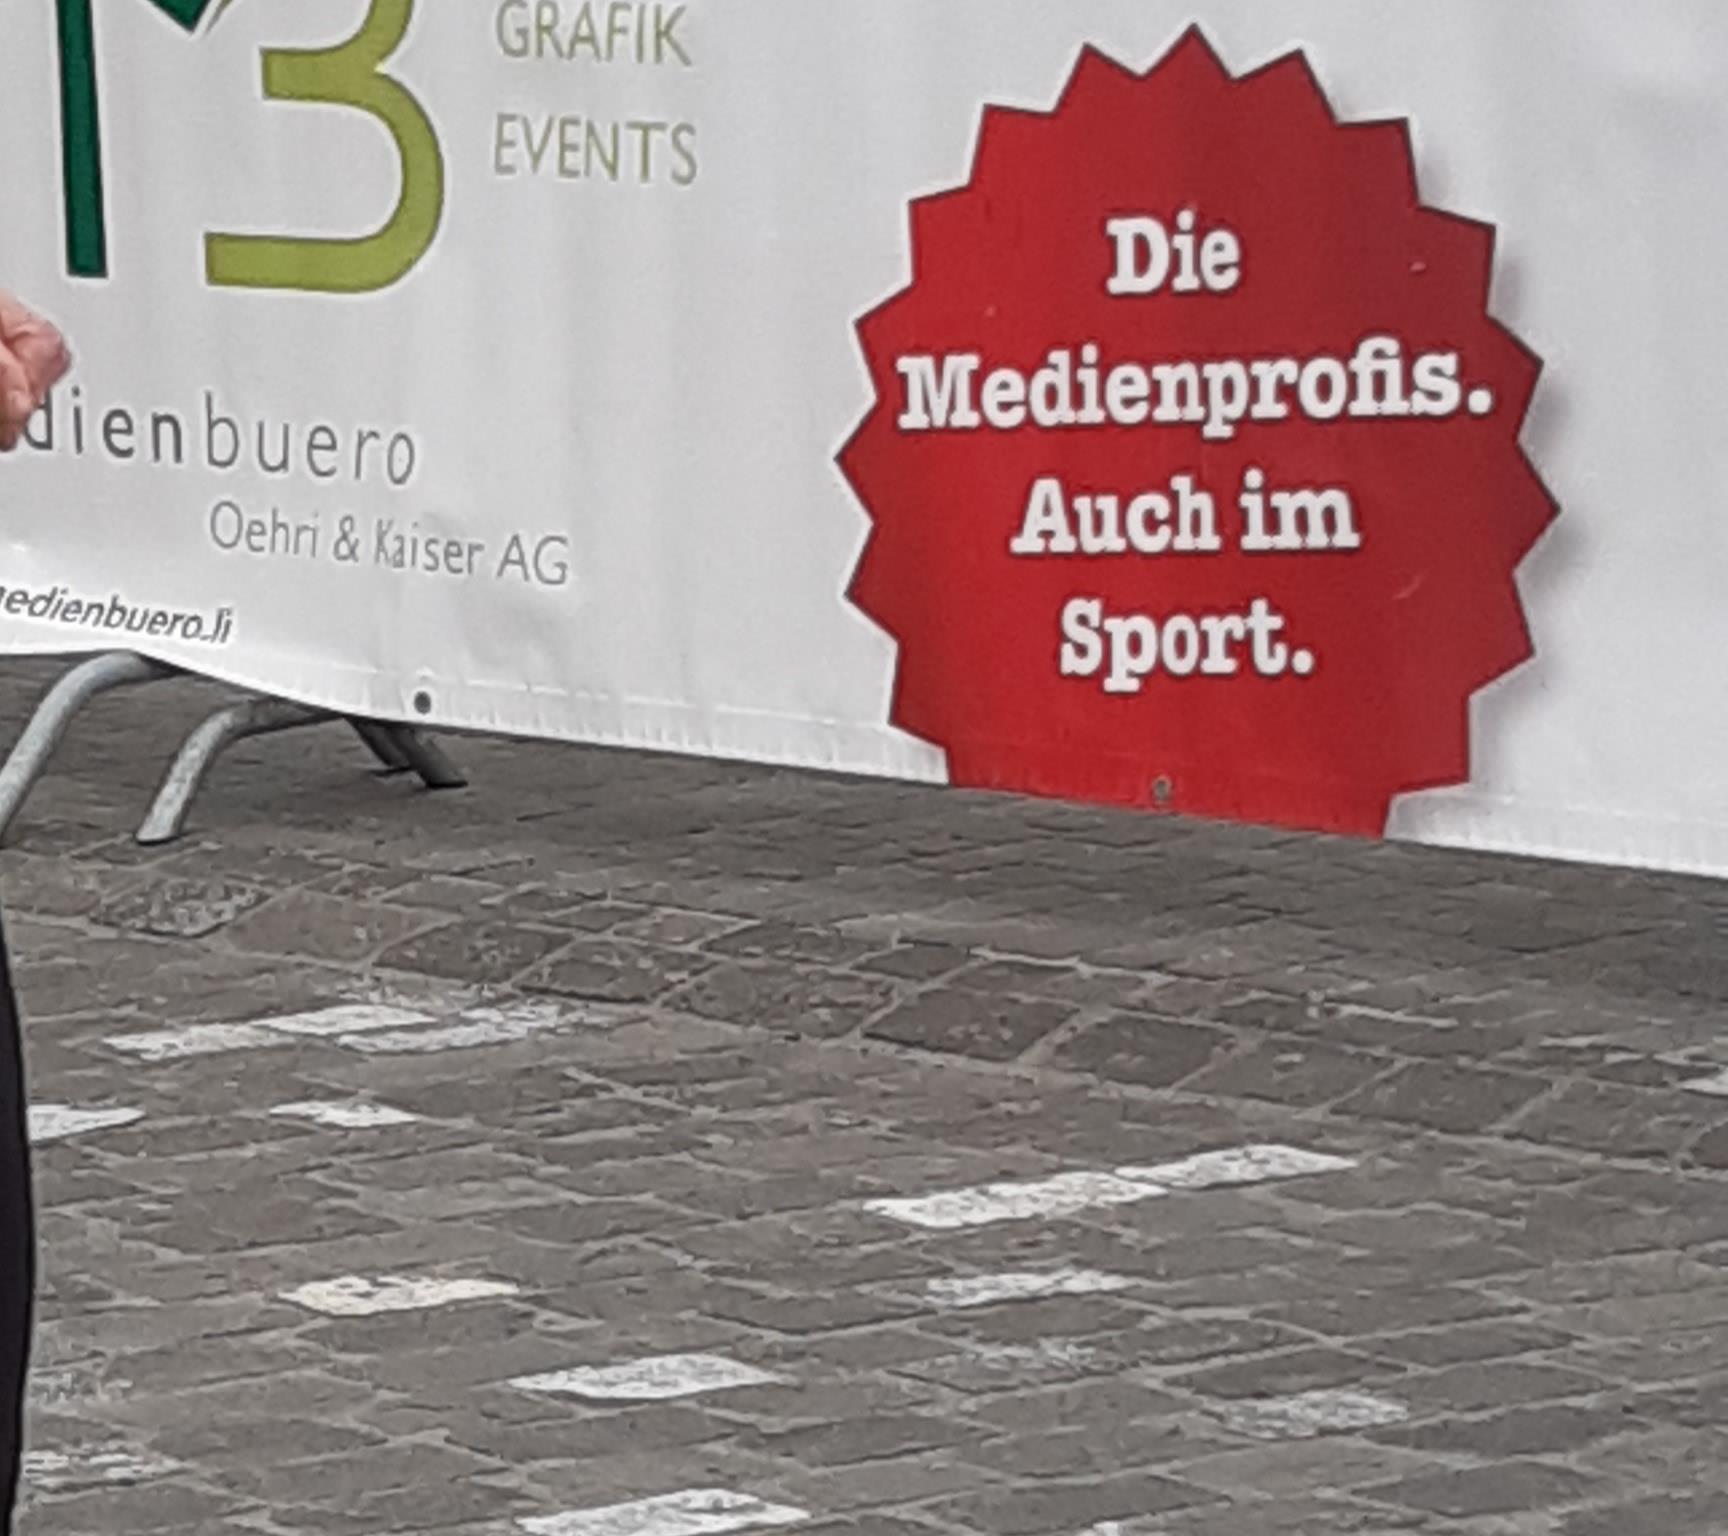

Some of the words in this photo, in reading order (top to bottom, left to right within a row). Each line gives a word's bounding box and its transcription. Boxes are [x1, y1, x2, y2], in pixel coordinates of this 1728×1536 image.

[494, 112, 699, 186] EVENTS
[1105, 209, 1241, 295] Die
[896, 336, 1494, 439] Medienprofis.
[208, 499, 318, 559] Oehri
[332, 516, 361, 565] &
[374, 517, 485, 576] Kaiser
[495, 532, 571, 588] AG
[1009, 473, 1221, 555] Auch
[1239, 468, 1361, 551] im
[1059, 596, 1315, 693] Sport.
